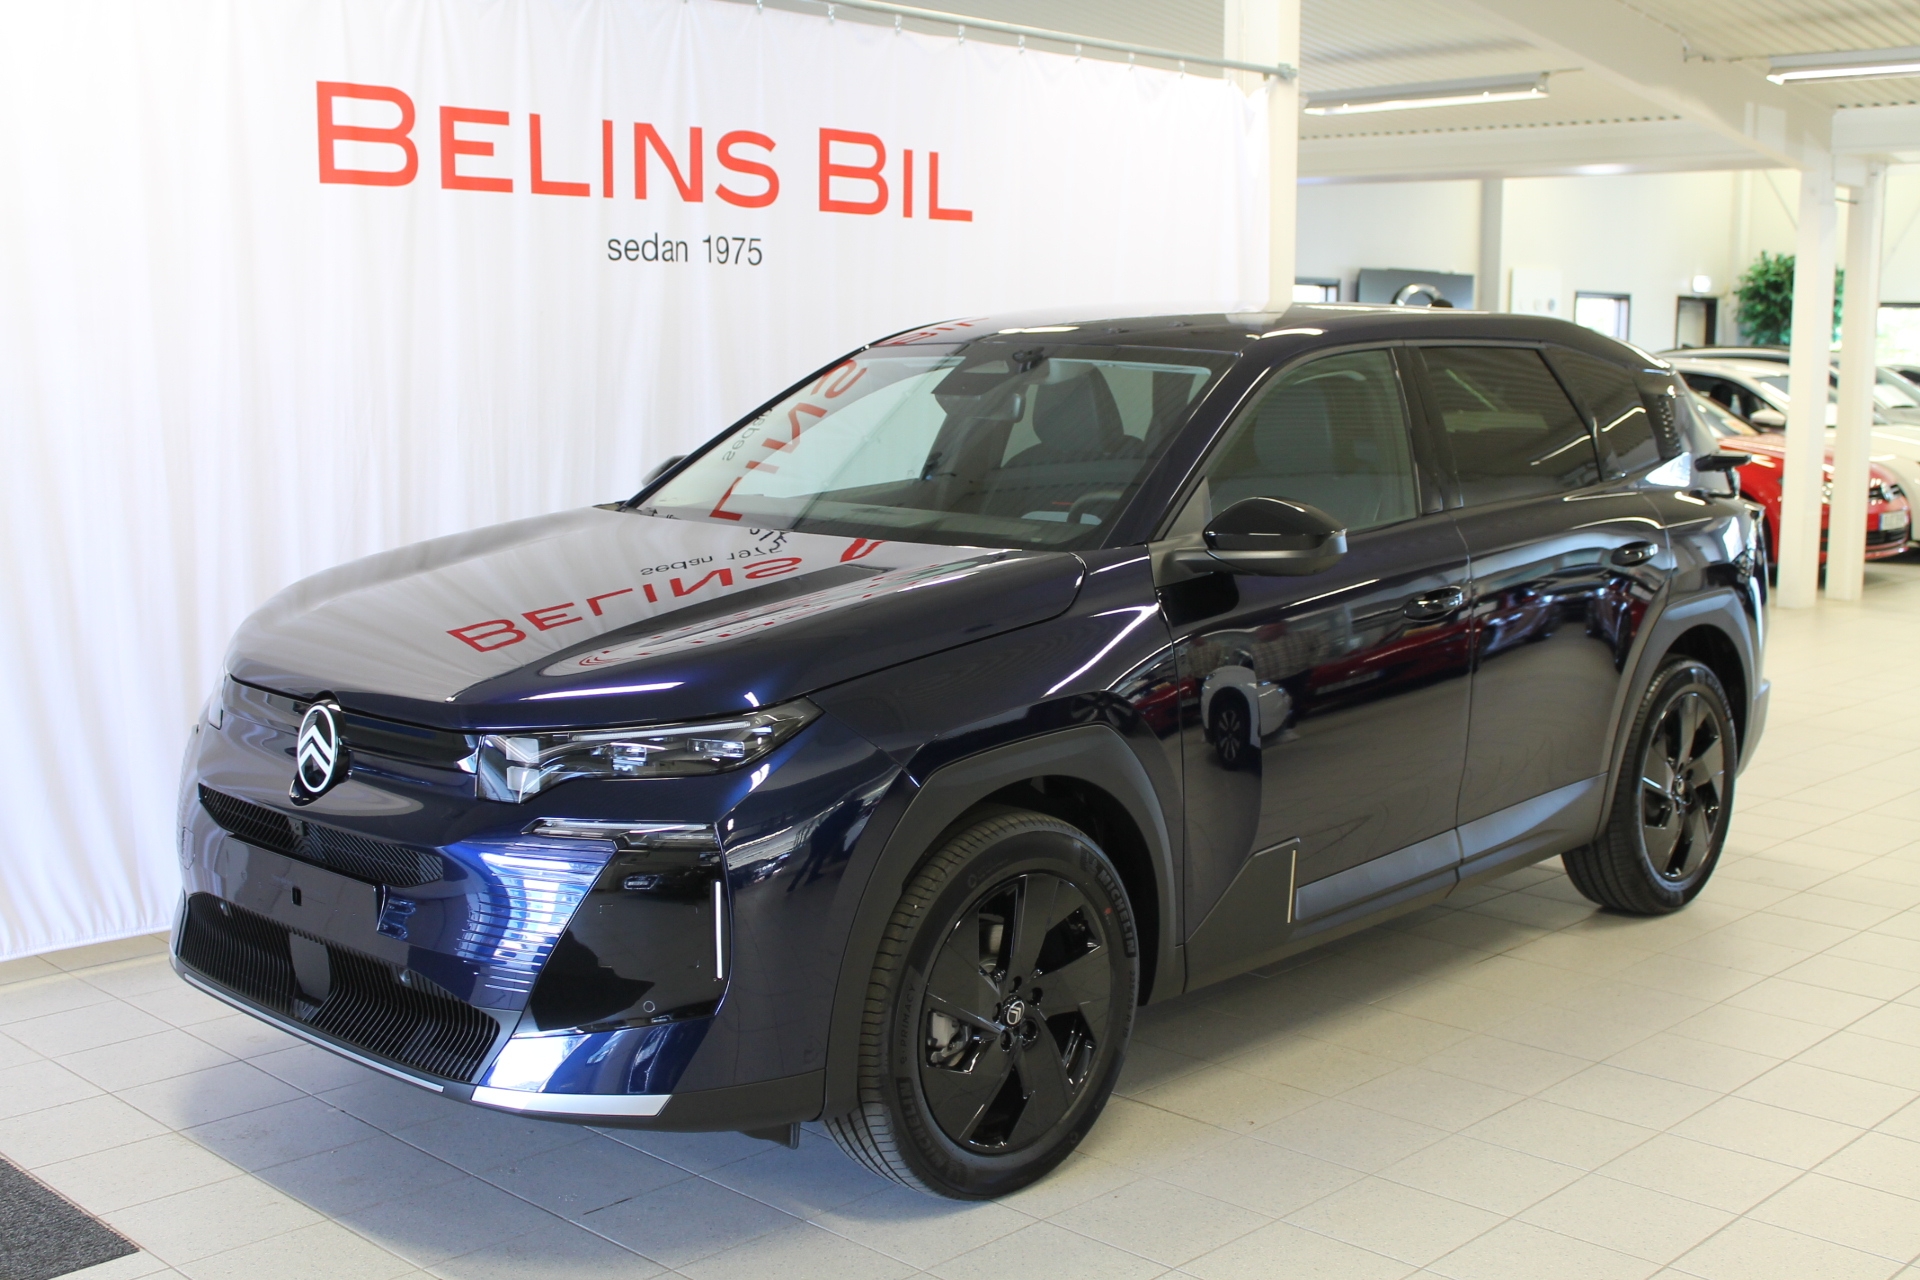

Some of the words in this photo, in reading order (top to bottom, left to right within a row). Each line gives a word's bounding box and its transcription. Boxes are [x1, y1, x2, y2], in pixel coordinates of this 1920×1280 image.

[316, 80, 780, 209] BELINS
[818, 127, 973, 222] BIL
[607, 232, 688, 263] sedan
[702, 235, 763, 266] 1975
[1099, 868, 1136, 955] MICHELIN
